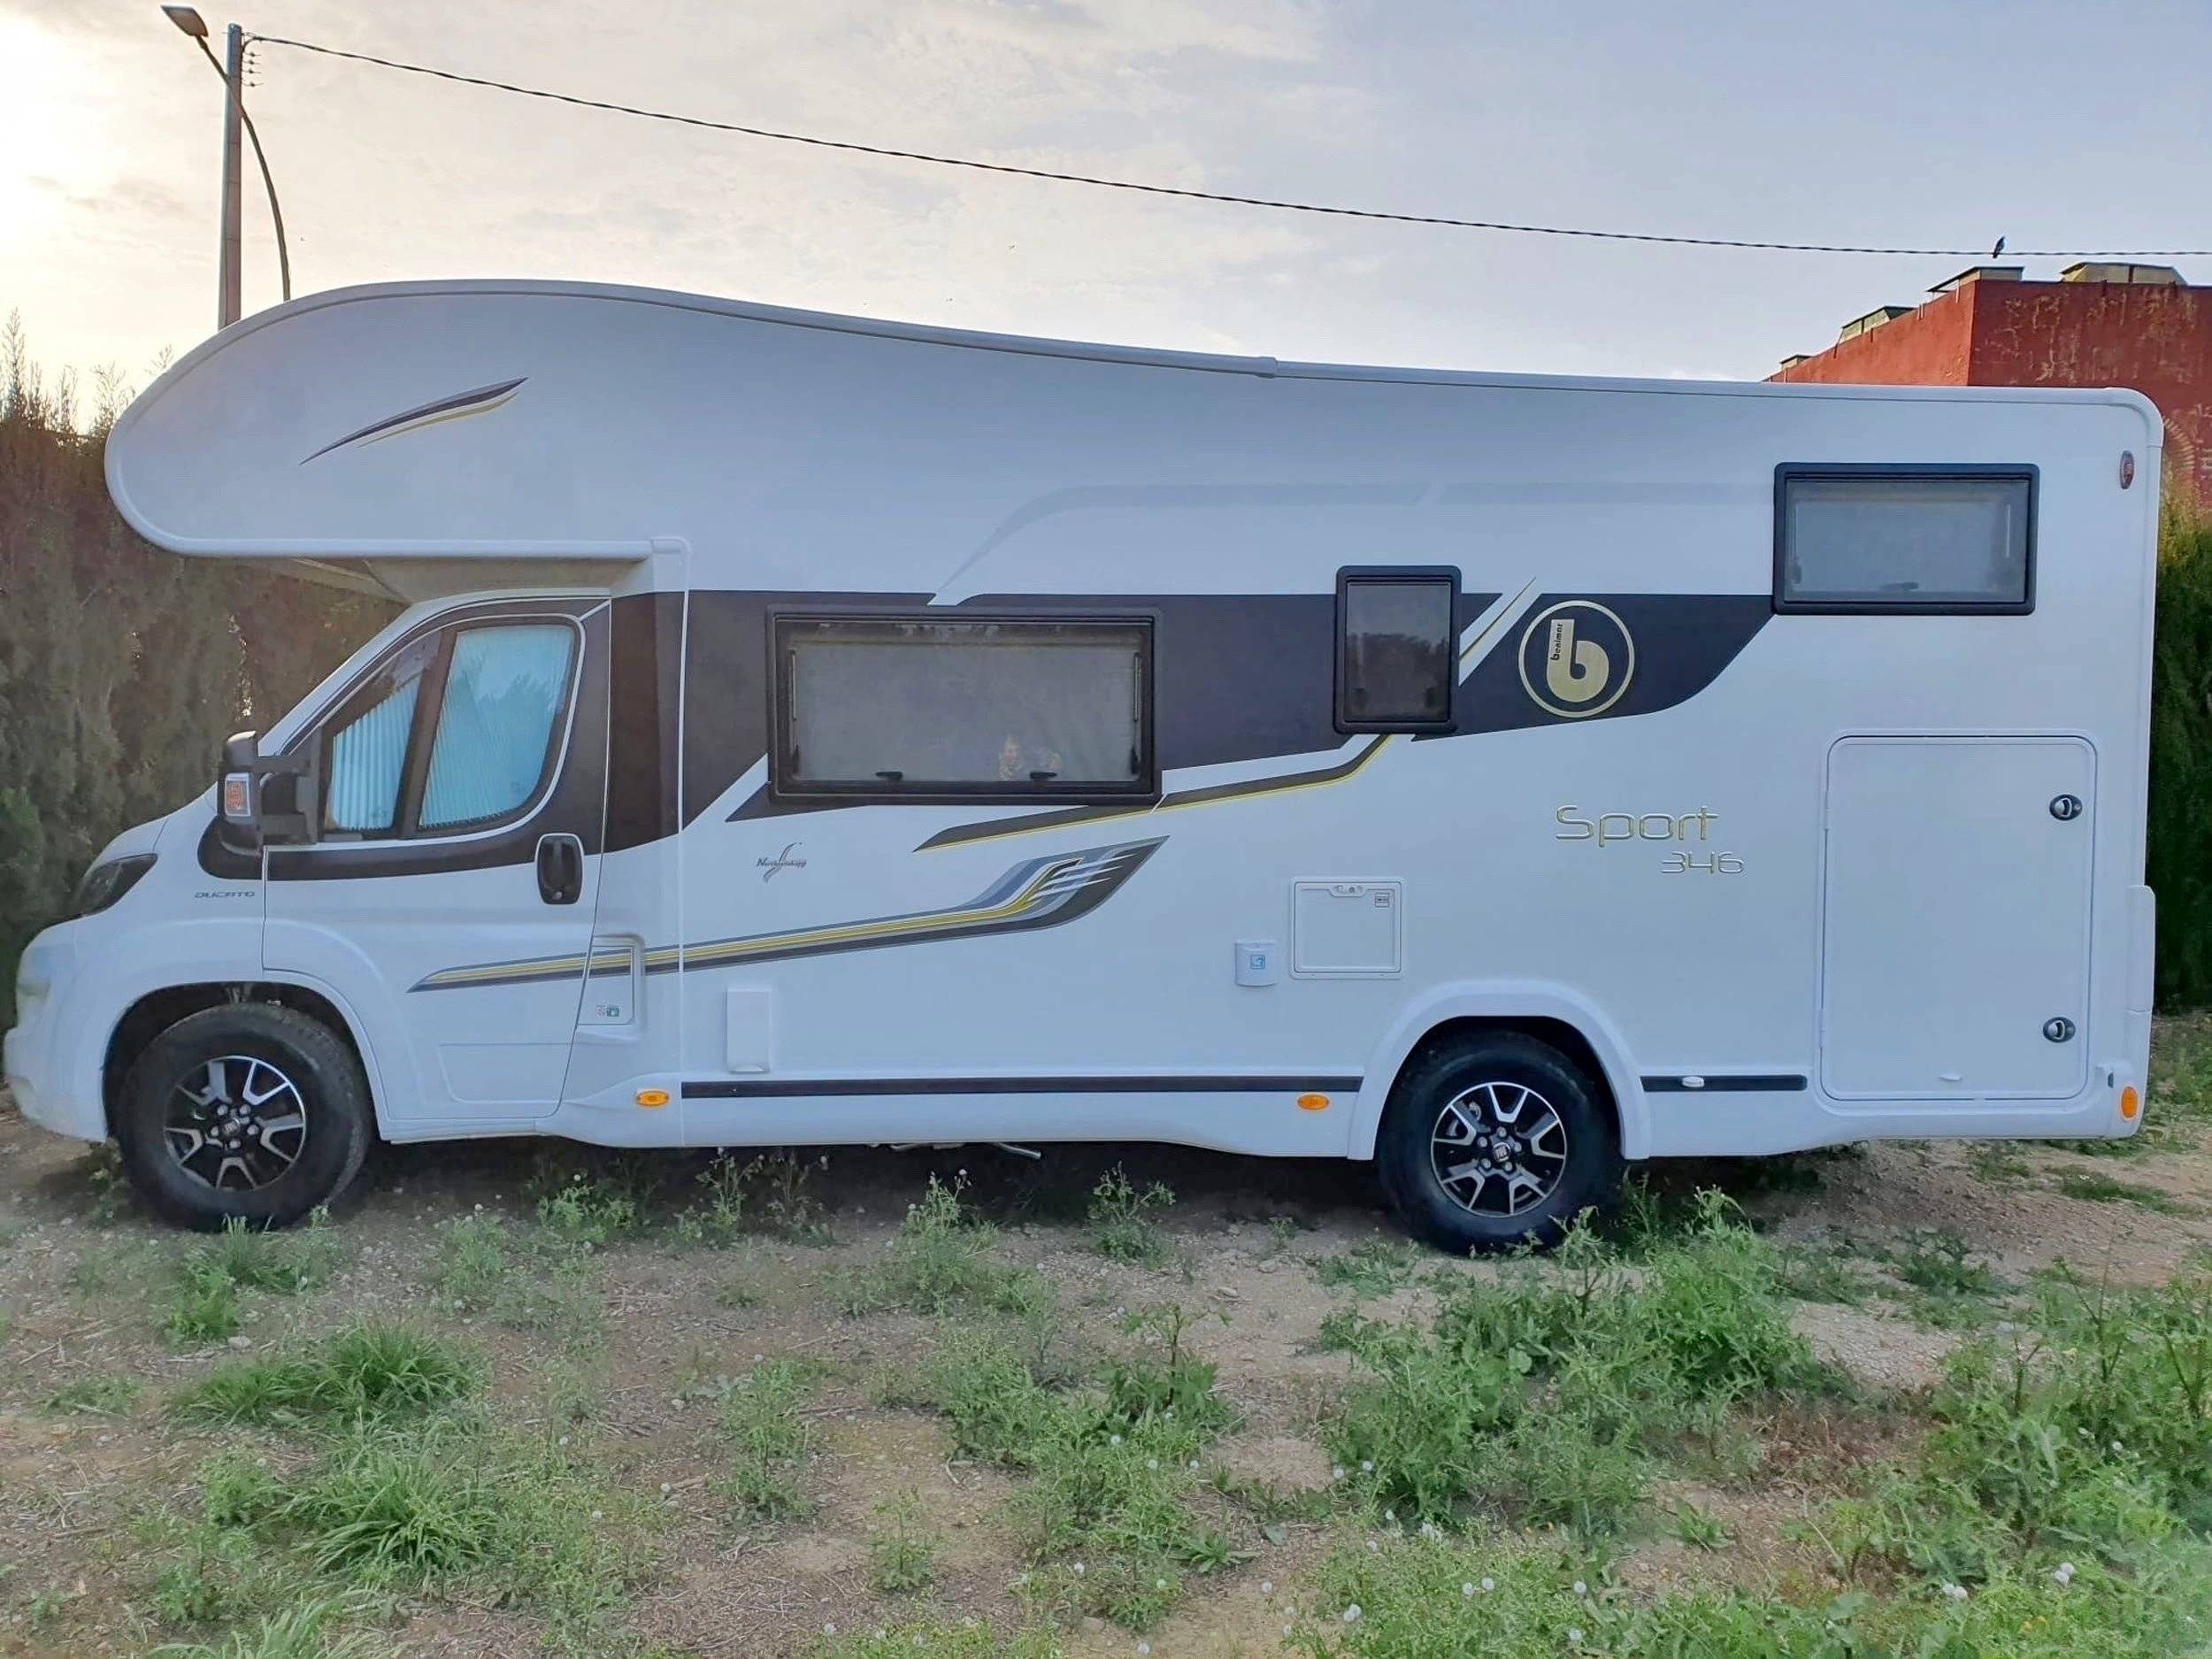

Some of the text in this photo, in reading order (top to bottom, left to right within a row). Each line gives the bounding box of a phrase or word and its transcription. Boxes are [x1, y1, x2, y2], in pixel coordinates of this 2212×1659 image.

[1547, 618, 1609, 703] b
[1555, 805, 1719, 848] Sport
[1660, 850, 1745, 874] 346
[195, 890, 256, 899] DUCATO
